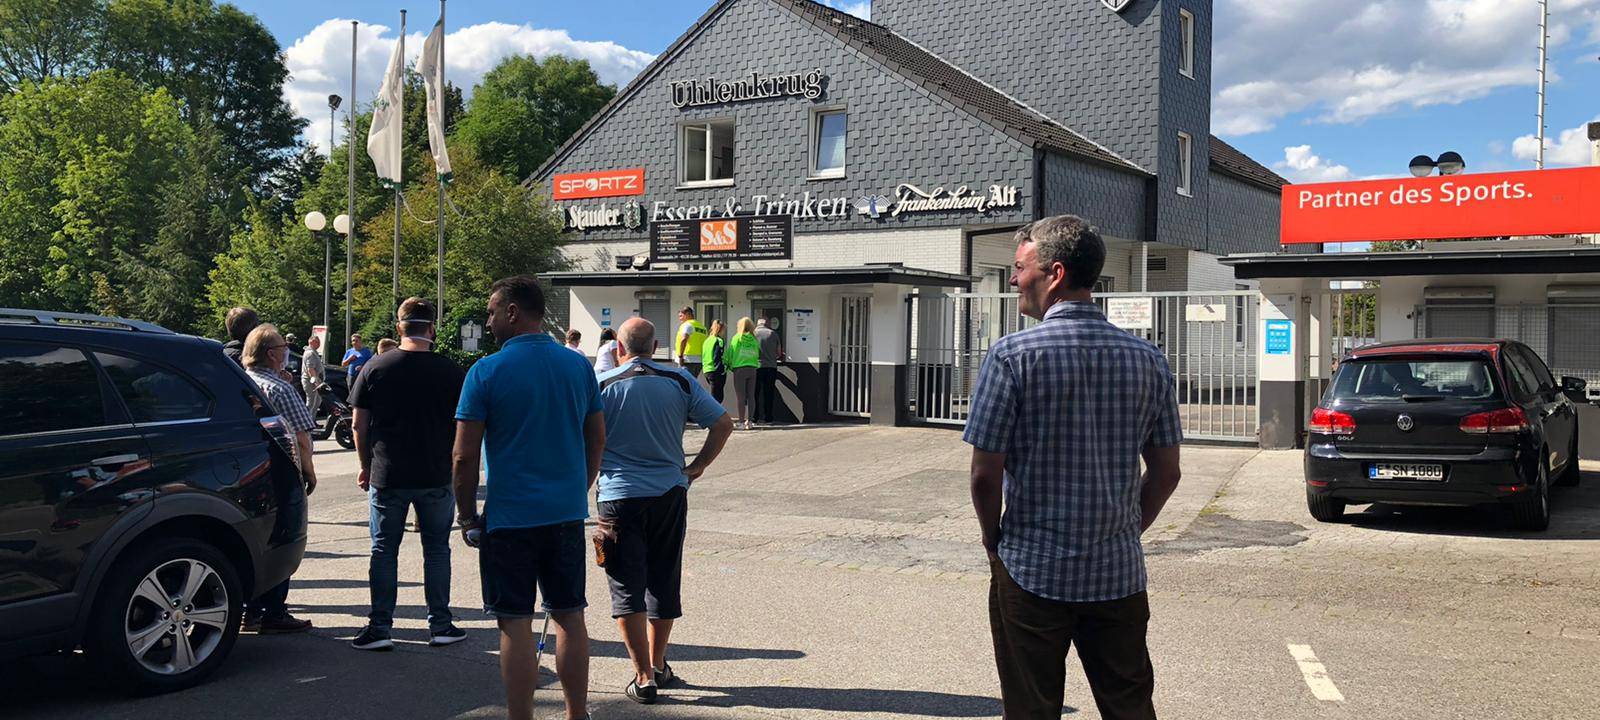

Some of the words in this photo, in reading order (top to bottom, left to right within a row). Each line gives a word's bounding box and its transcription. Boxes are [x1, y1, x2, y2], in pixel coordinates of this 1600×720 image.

[670, 68, 822, 108] Uhlenkrug
[559, 175, 637, 194] SPORTZ
[1299, 189, 1383, 209] Partner
[1389, 184, 1433, 205] des
[1439, 180, 1533, 207] Sports.
[652, 200, 711, 221] Essen
[721, 196, 743, 218] &
[751, 191, 847, 218] Trinken
[891, 183, 986, 217] Frankenheim
[987, 184, 1017, 209] Alt
[1377, 464, 1385, 475] E
[1393, 464, 1408, 476] SN
[1411, 465, 1441, 477] 1080
